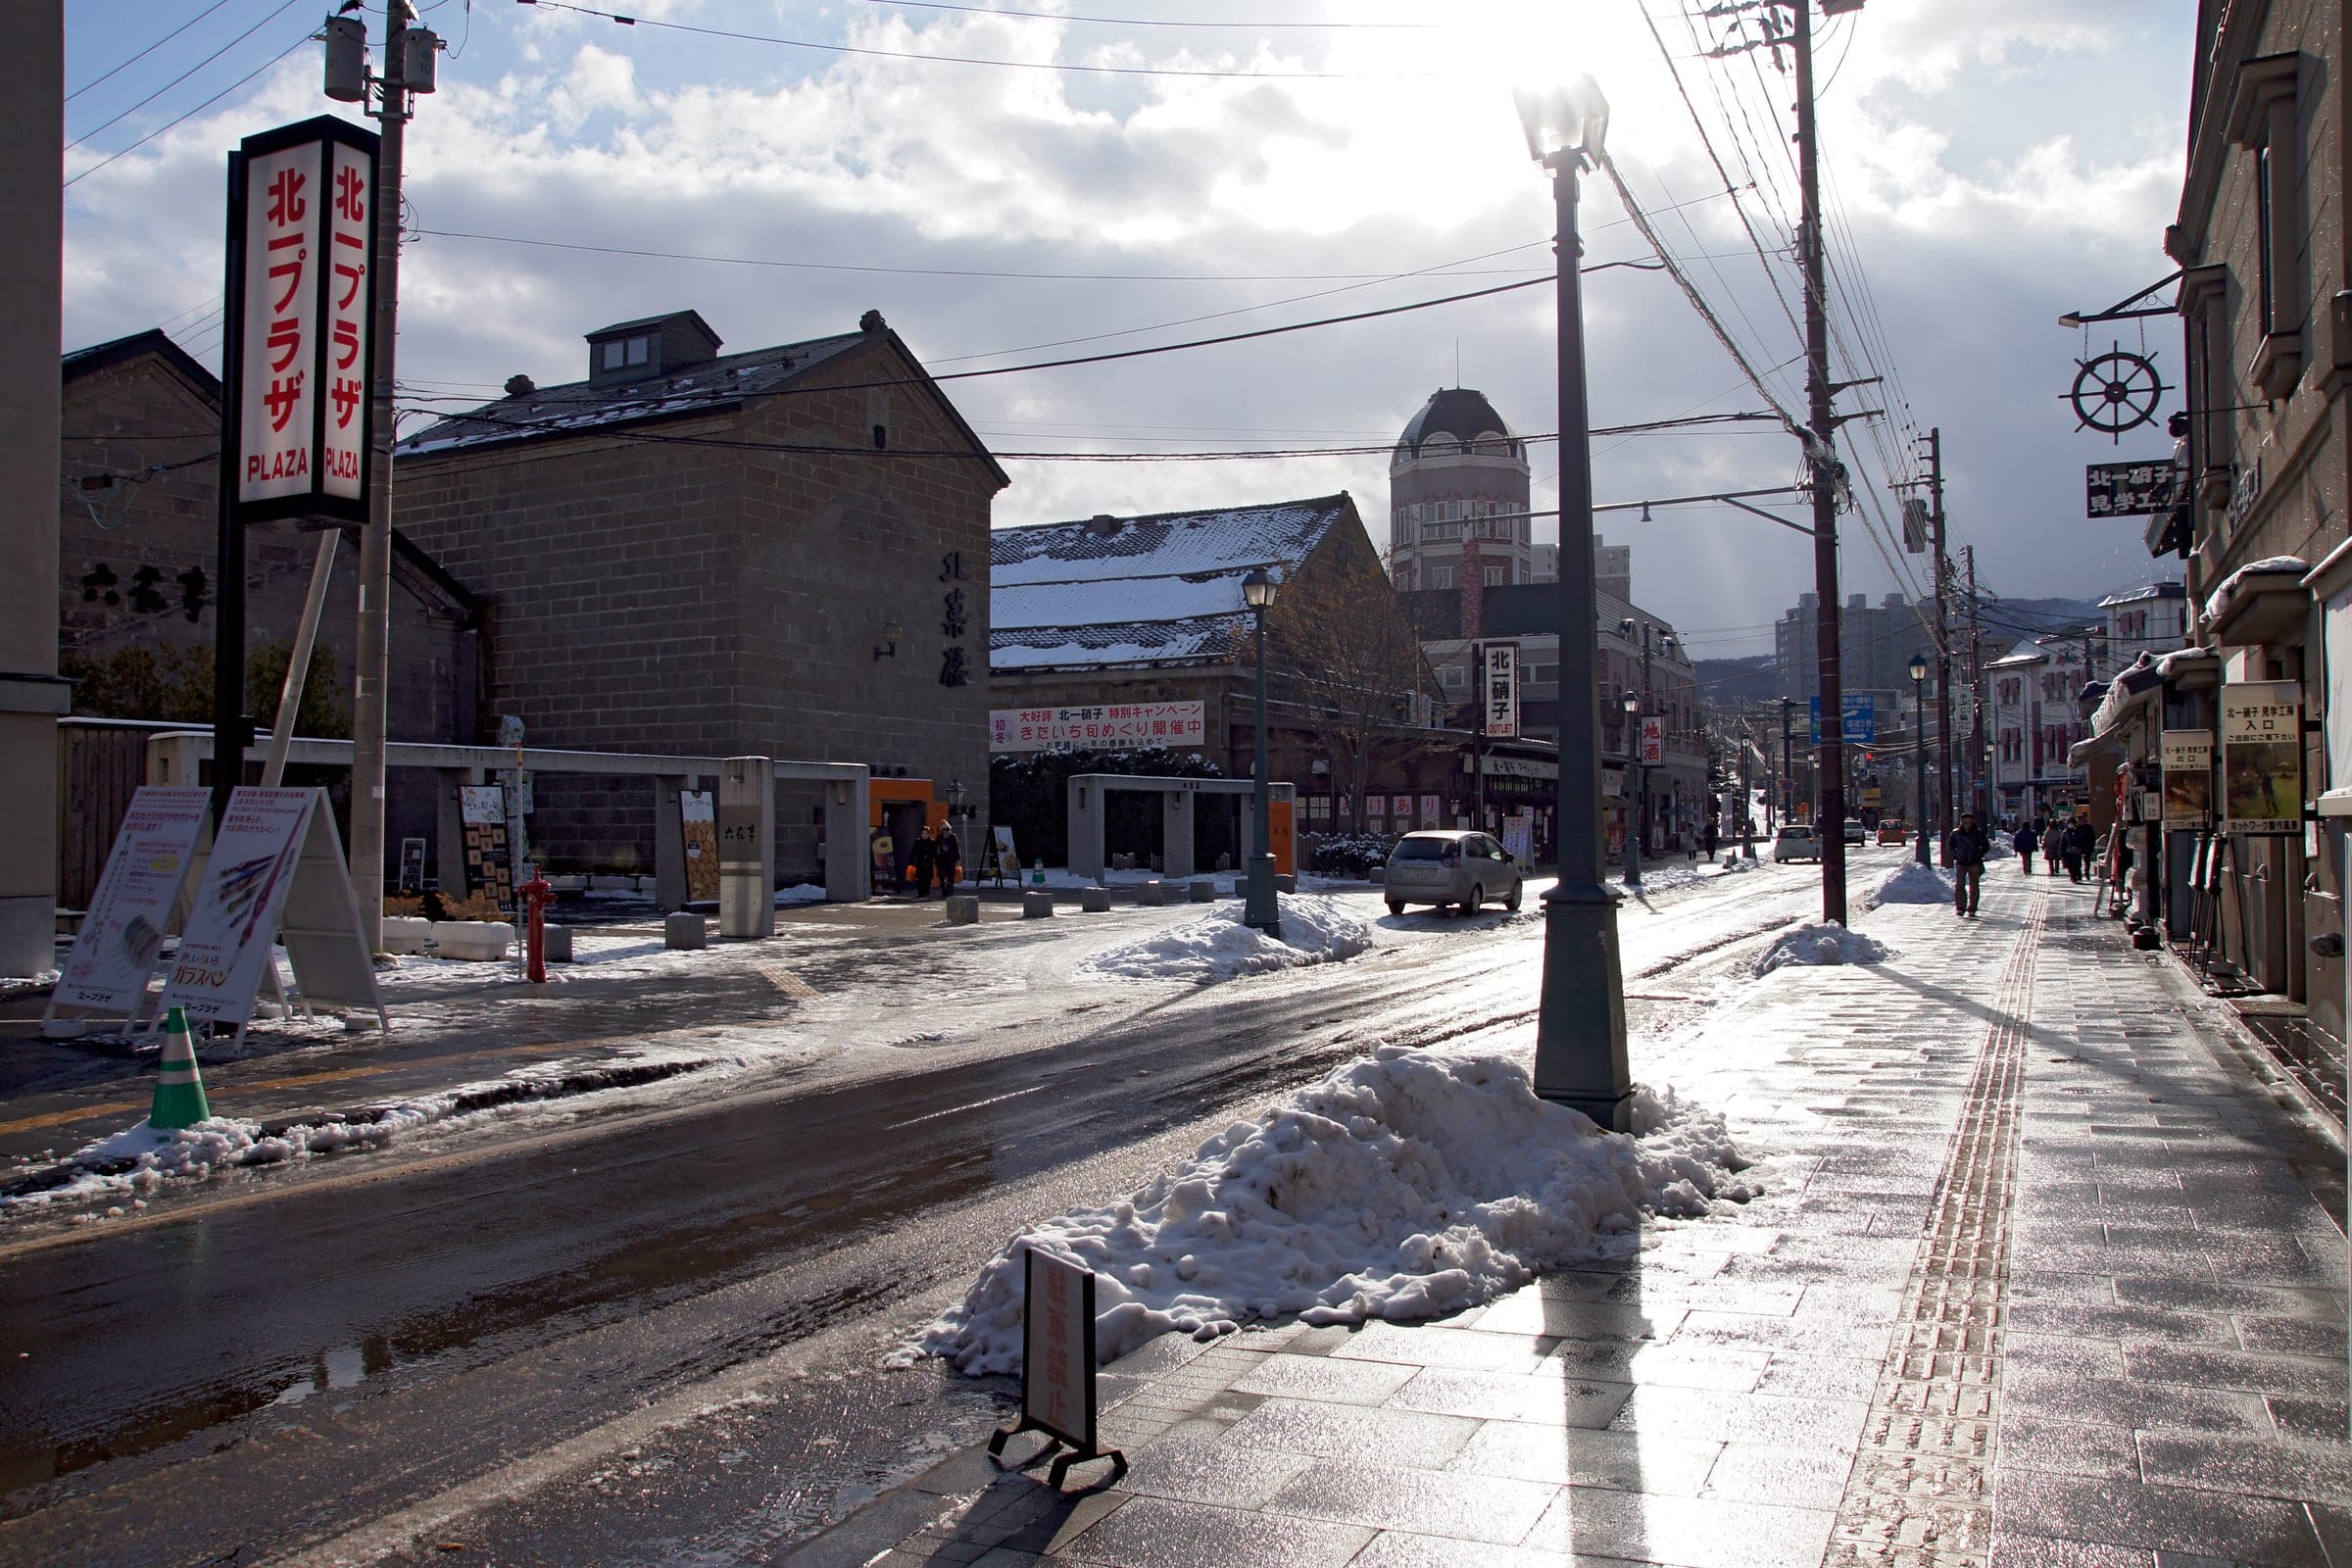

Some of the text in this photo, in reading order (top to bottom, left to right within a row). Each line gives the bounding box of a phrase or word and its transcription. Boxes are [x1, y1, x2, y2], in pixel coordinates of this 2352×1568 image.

[264, 168, 307, 433] 北一プラザ
[331, 165, 366, 429] 北一プラザ
[247, 447, 309, 483] PLAZA
[325, 446, 359, 480] PLAZA
[2089, 466, 2174, 487] 北一硝子
[1492, 651, 1509, 720] 北一硝子
[1019, 704, 1201, 723] 大好評 北一硝子 特別キャンペーン
[2227, 706, 2294, 718] 北一硝子 見学工房
[995, 718, 1005, 744] 初冬
[1019, 718, 1201, 741] きたいち旬めぐり開催中
[1489, 723, 1513, 734] OUTLET
[2245, 720, 2274, 730] 入口
[1642, 721, 1660, 760] 地酒
[2228, 733, 2296, 742] ご自由にご覧下さい
[724, 824, 757, 843] 六花亭
[172, 965, 228, 989] ガラスペン
